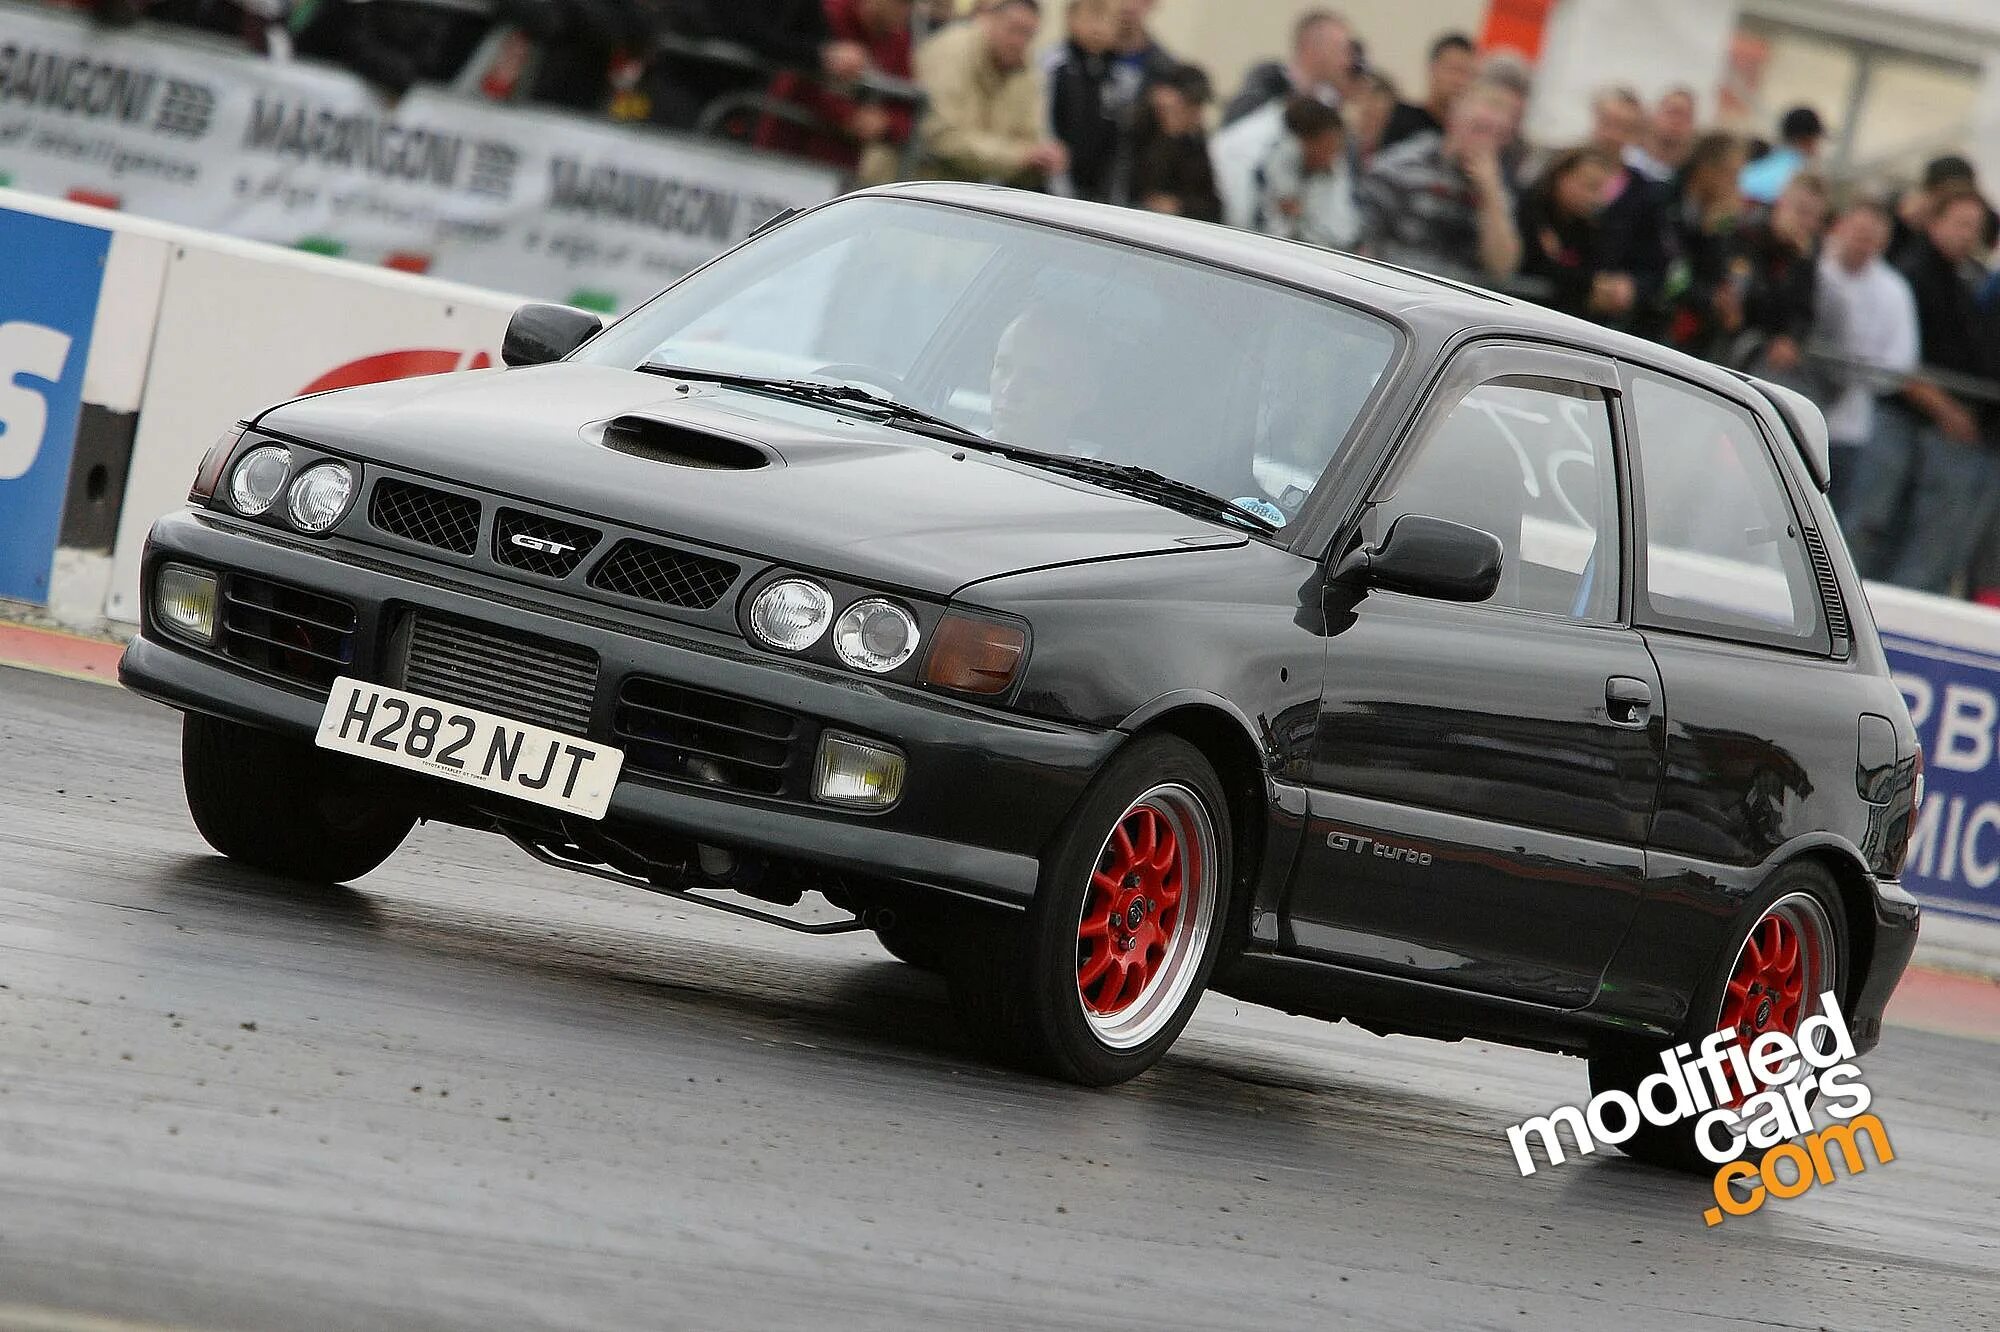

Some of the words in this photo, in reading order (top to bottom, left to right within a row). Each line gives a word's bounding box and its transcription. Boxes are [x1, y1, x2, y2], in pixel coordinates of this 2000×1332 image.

[511, 534, 577, 555] GT
[338, 688, 476, 769] H282
[481, 725, 597, 799] NJT
[1326, 831, 1372, 853] GT
[1373, 842, 1432, 866] turbo
